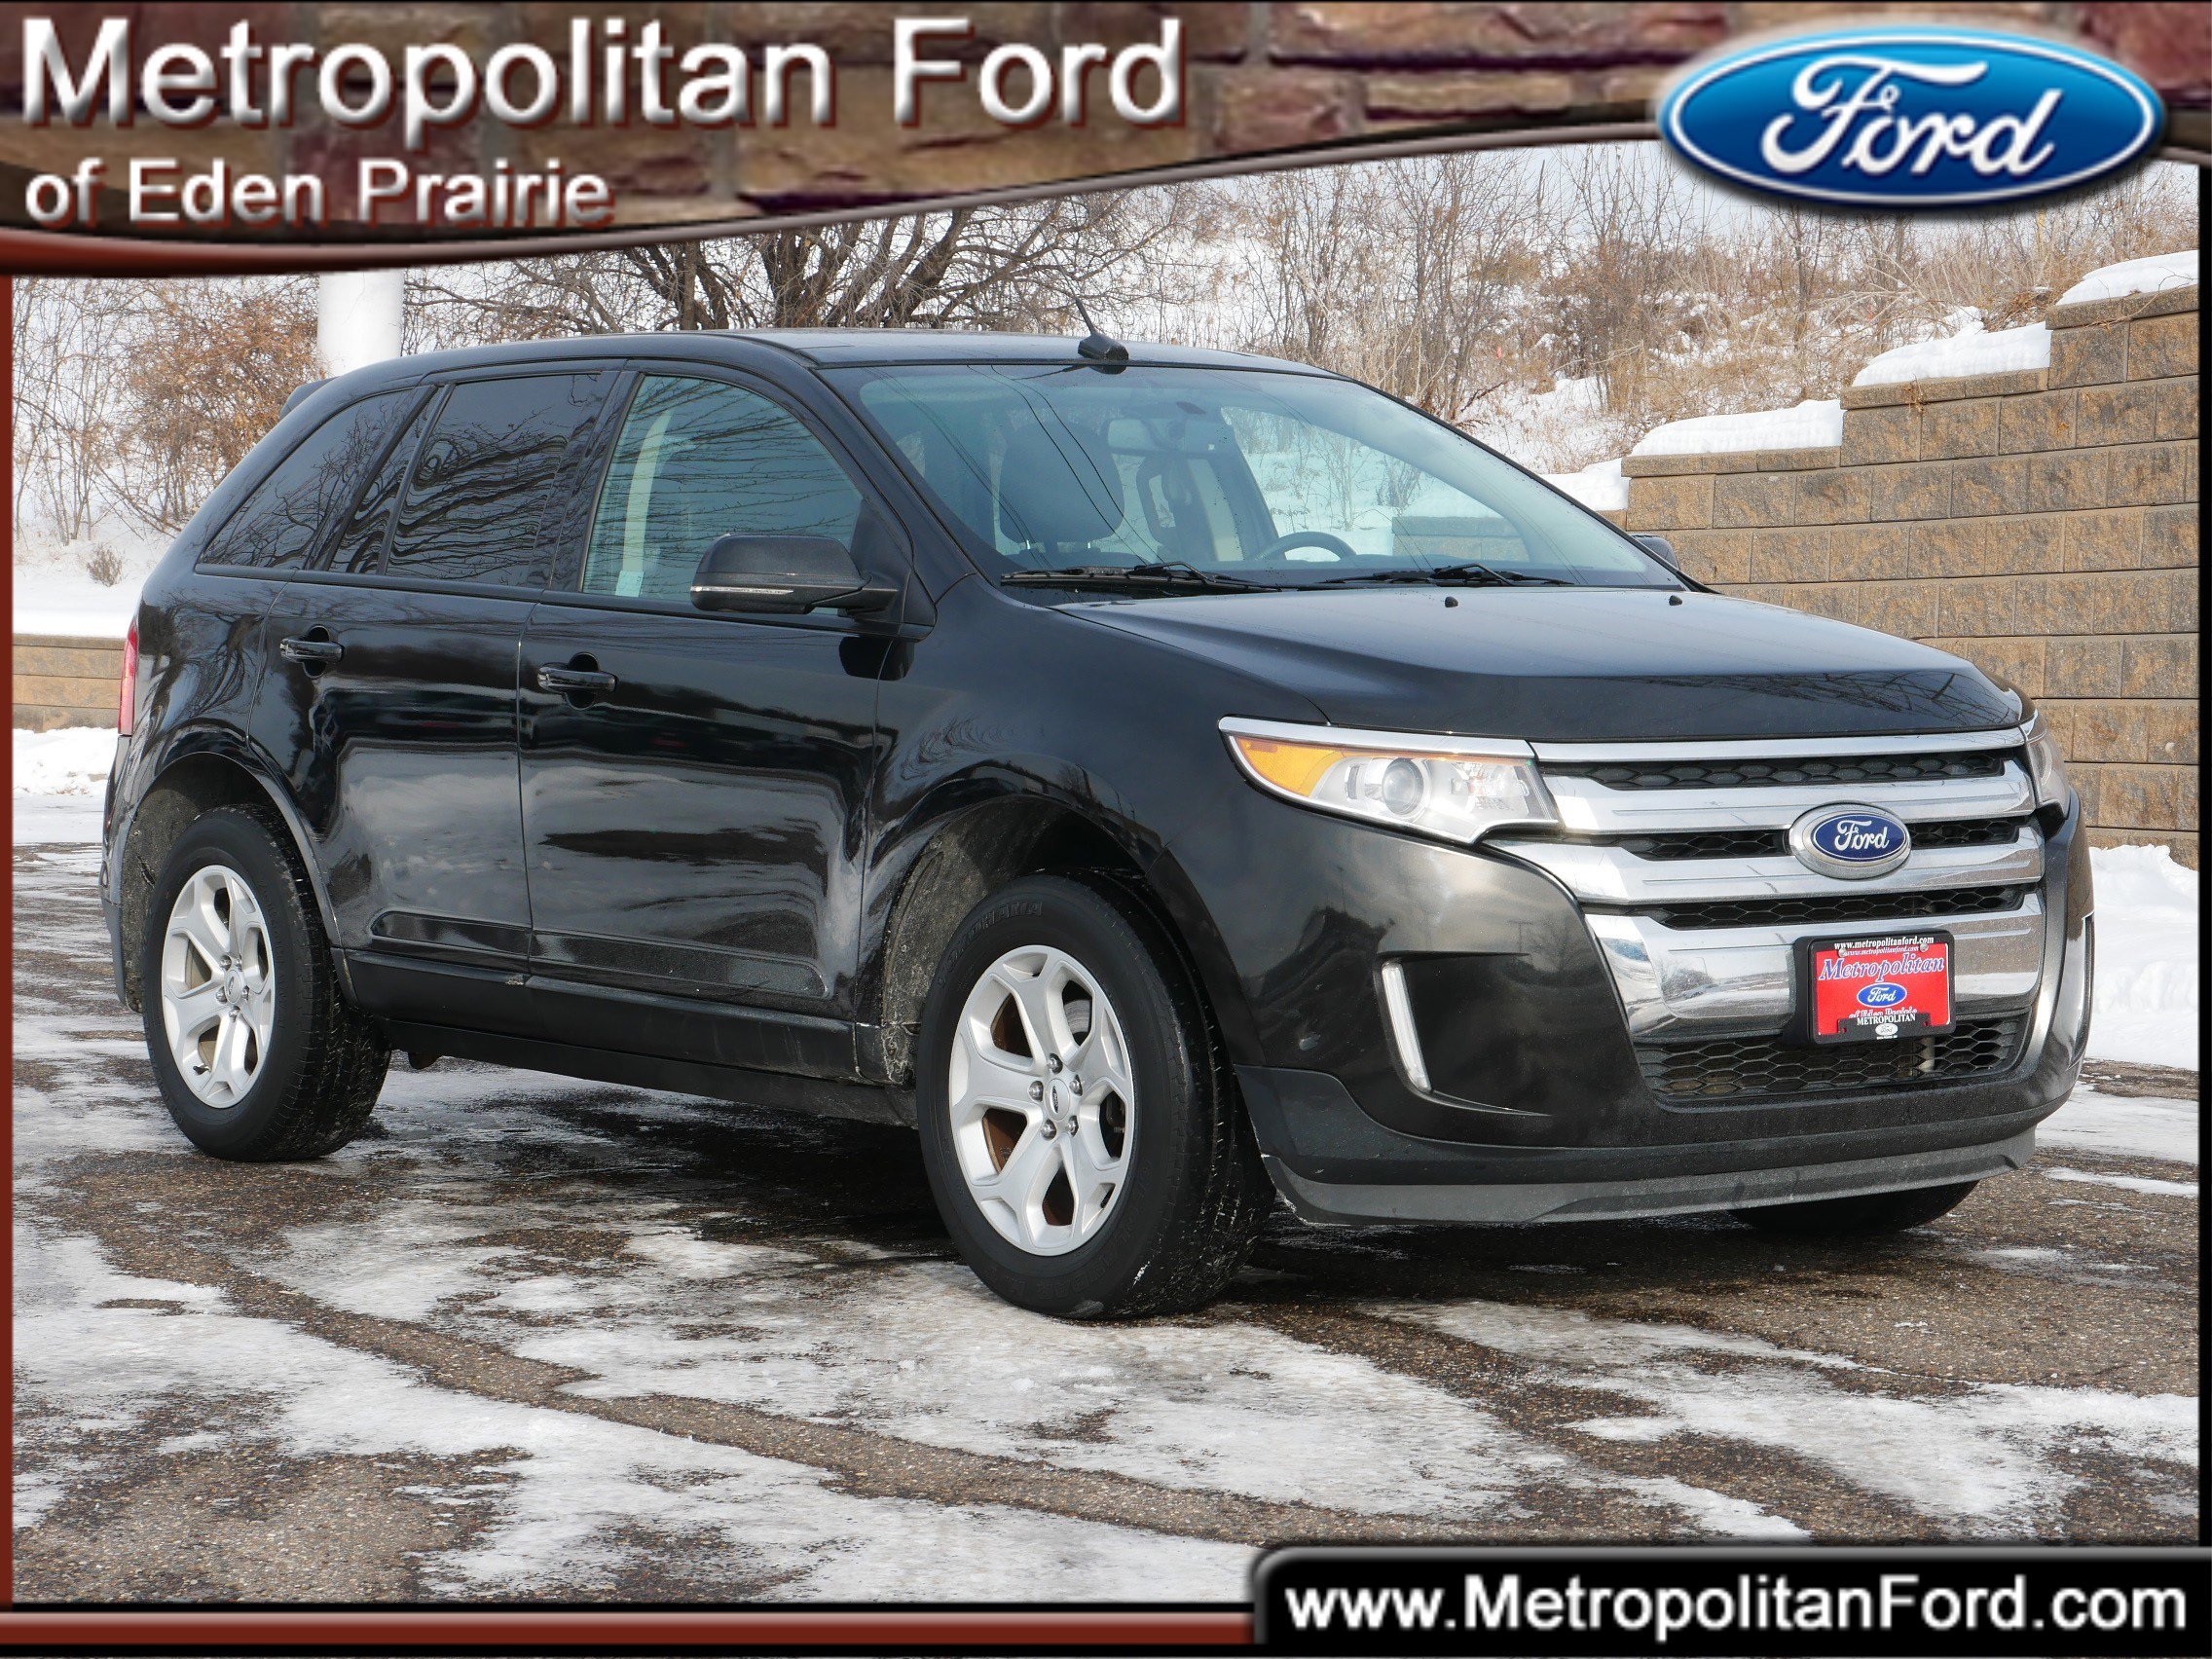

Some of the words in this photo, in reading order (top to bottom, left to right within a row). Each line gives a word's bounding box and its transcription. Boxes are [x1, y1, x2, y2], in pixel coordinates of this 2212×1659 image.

[1834, 820, 1890, 851] Ford
[1834, 936, 1935, 950] www.metropolitanford.com
[1818, 952, 1945, 982] Metropolitan
[1867, 986, 1897, 1003] Ford
[1857, 1013, 1916, 1026] METROPOLITAN
